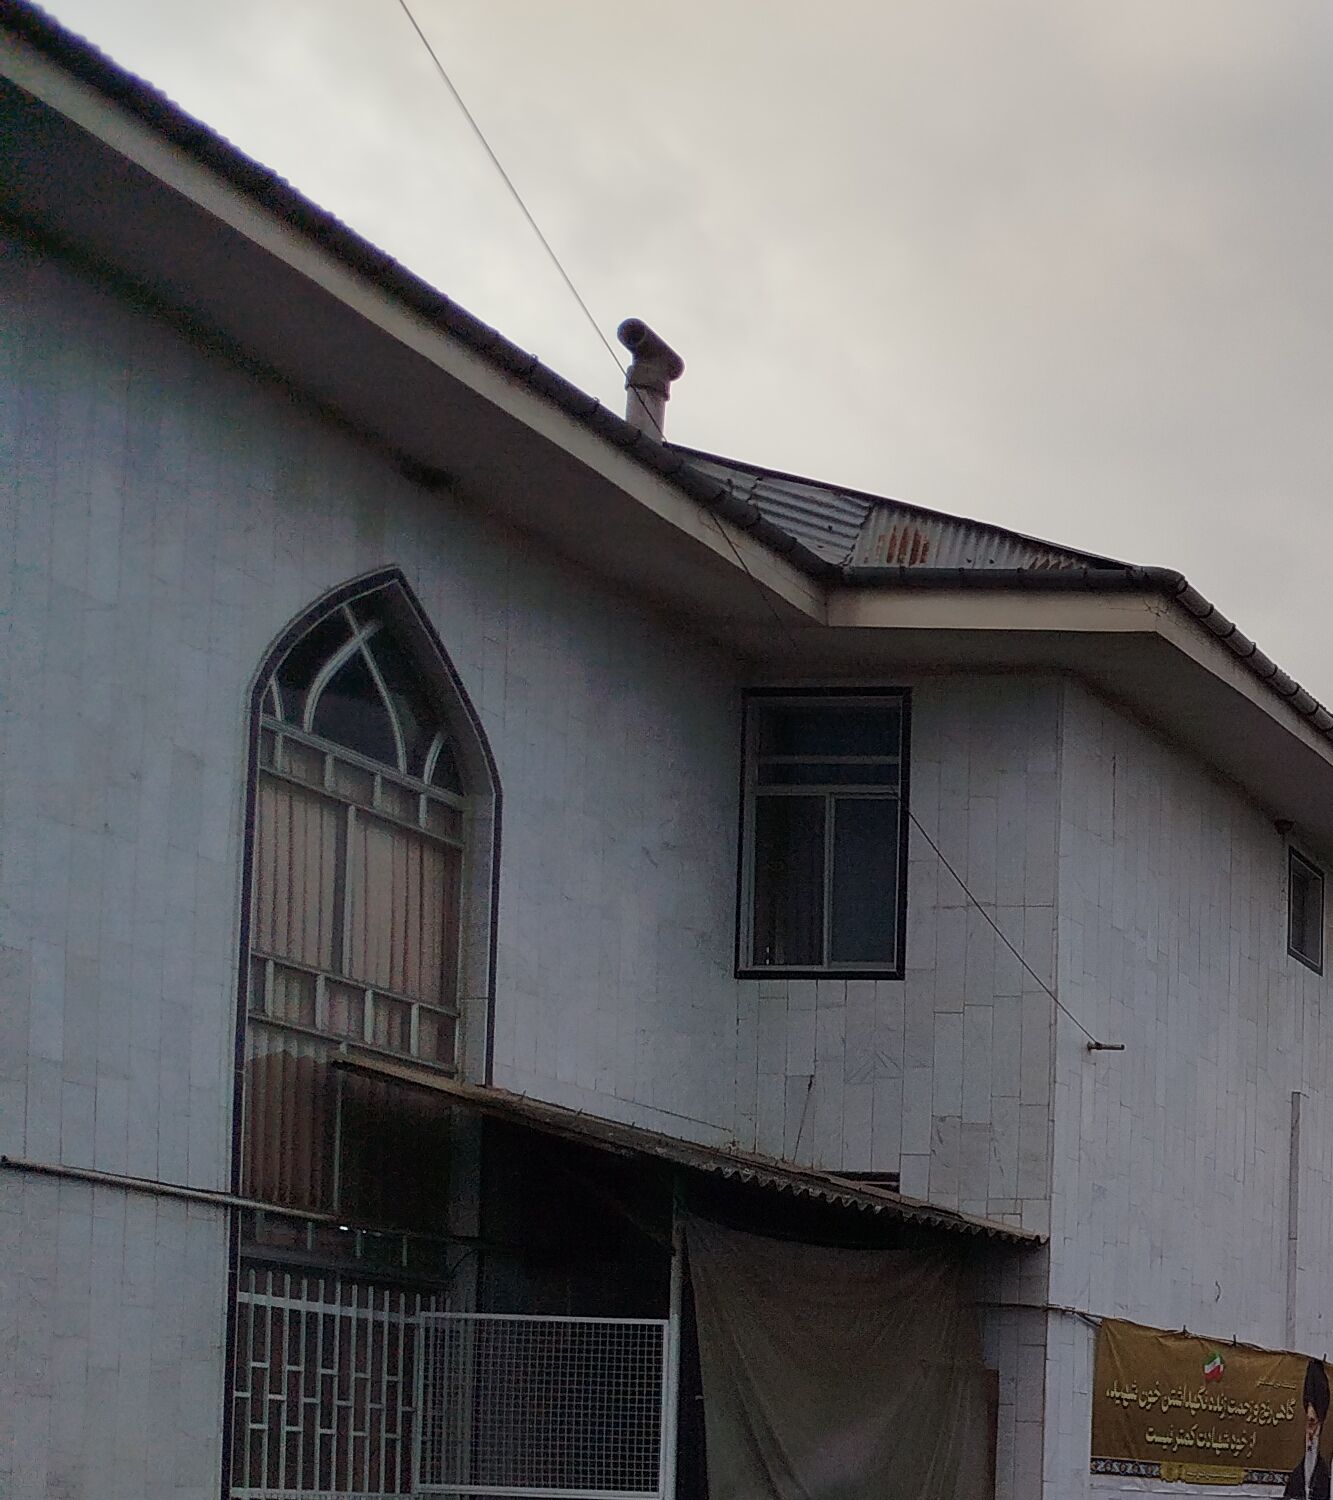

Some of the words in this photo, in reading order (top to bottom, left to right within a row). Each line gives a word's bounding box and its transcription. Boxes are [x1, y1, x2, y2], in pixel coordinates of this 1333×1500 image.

[1139, 1380, 1161, 1411] خون
[1145, 1423, 1173, 1451] نیست
[1173, 1423, 1199, 1452] کمتر
[1196, 1425, 1230, 1456] شهادت
[1231, 1429, 1248, 1457] خود
[1246, 1431, 1257, 1459] از
